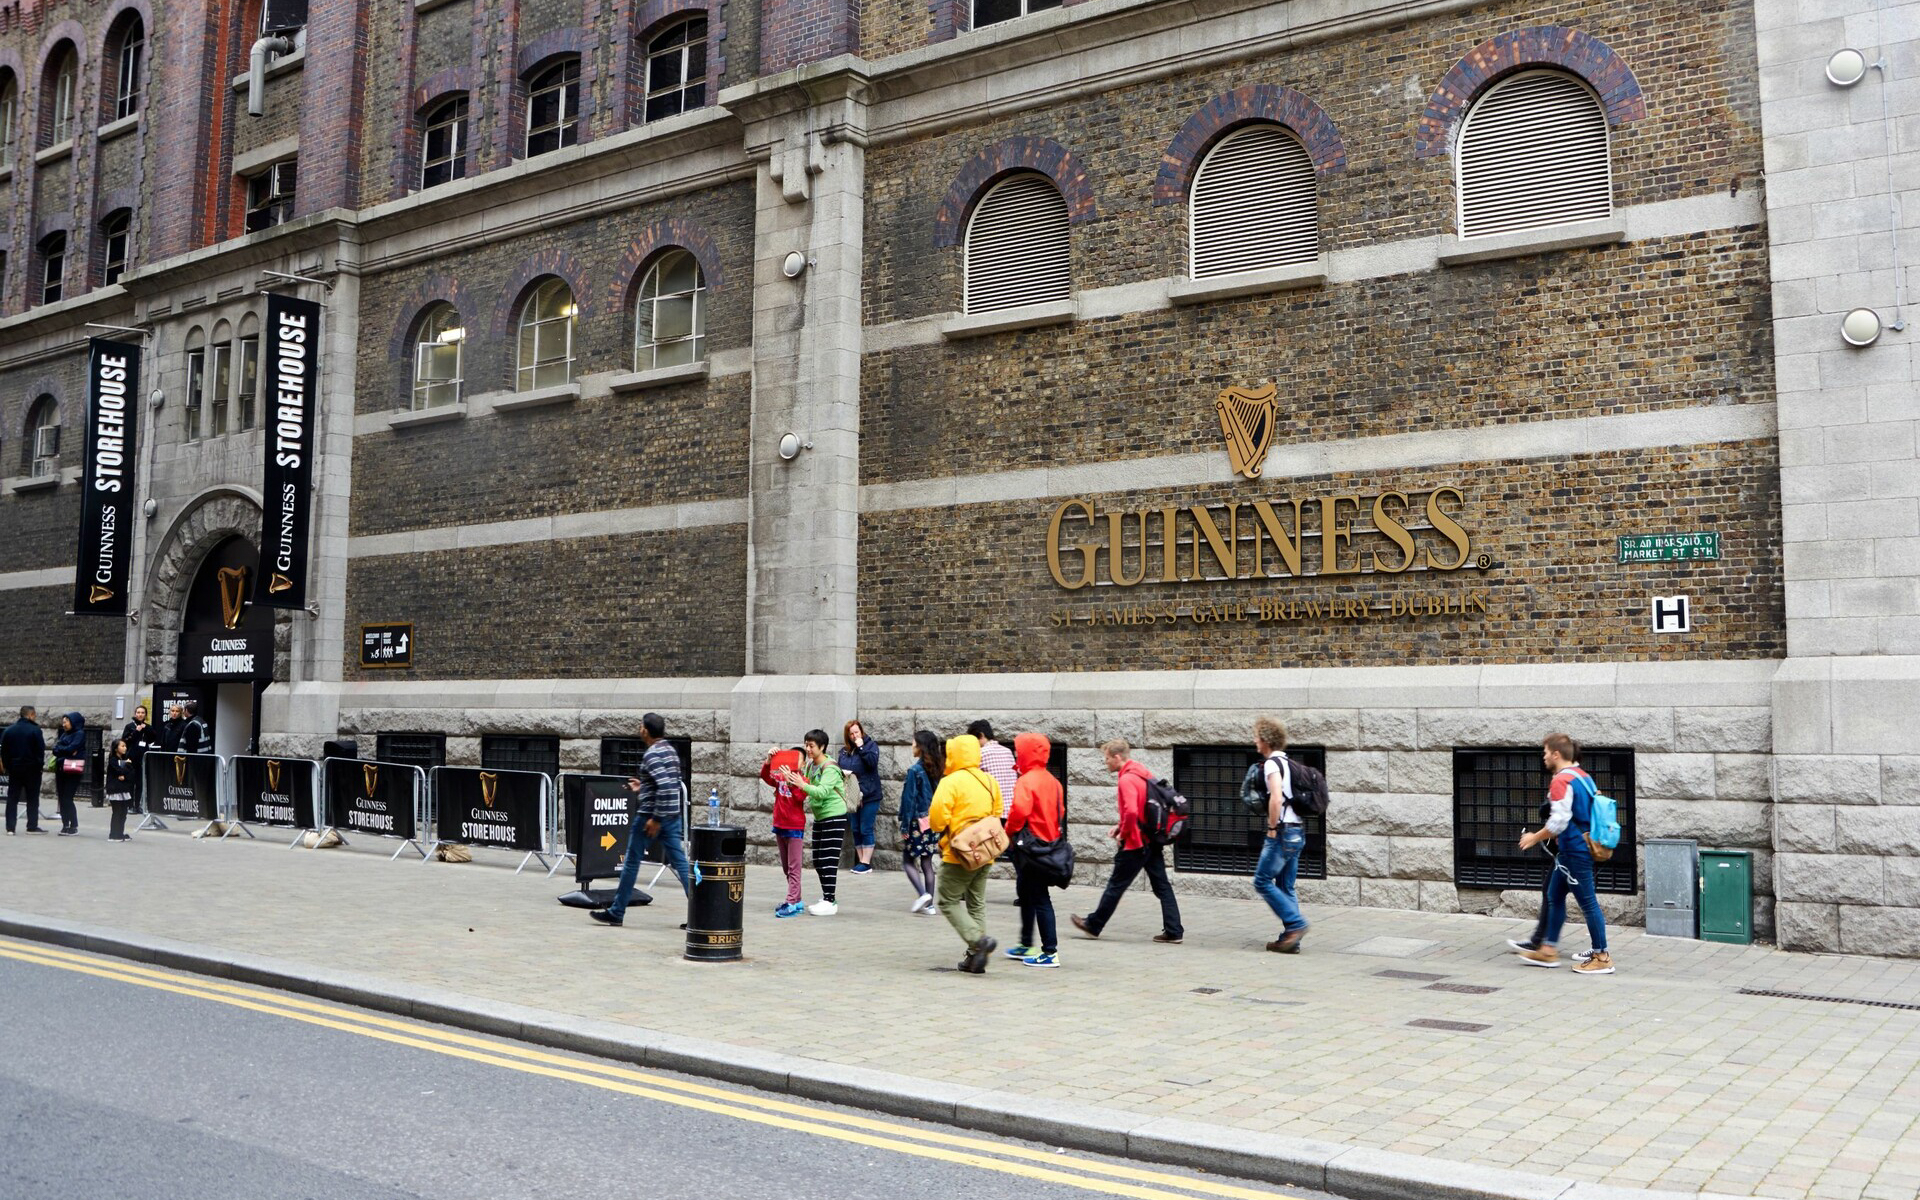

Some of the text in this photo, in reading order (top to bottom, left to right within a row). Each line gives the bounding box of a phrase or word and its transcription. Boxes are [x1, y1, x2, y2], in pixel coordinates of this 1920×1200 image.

[276, 311, 306, 571] GUINNESS STOREHOUSE
[95, 354, 127, 584] GUINNESS STOREHOUSE
[1046, 486, 1471, 590] GUINNESS
[1624, 548, 1664, 559] MARKET
[1693, 547, 1713, 556] STH
[1191, 603, 1249, 623] GATE
[1391, 593, 1488, 617] DUBLIN
[1656, 598, 1685, 629] H
[211, 638, 247, 652] GUINNESS
[202, 654, 255, 674] STOREHOUSE
[168, 785, 194, 797] GUINNESS
[261, 791, 290, 804] GUINNESS
[163, 797, 200, 813] STOREHOUSE
[356, 797, 387, 811] GUINNESS
[594, 798, 628, 811] ONLINE
[255, 804, 295, 822] STOREHOUSE
[348, 810, 394, 831] STOREHOUSE
[471, 807, 509, 822] GUINNESS
[590, 813, 629, 826] TICKETS
[462, 822, 516, 843] STOREHOUSE
[717, 867, 744, 876] LITTE
[708, 935, 742, 944] BRUSC
